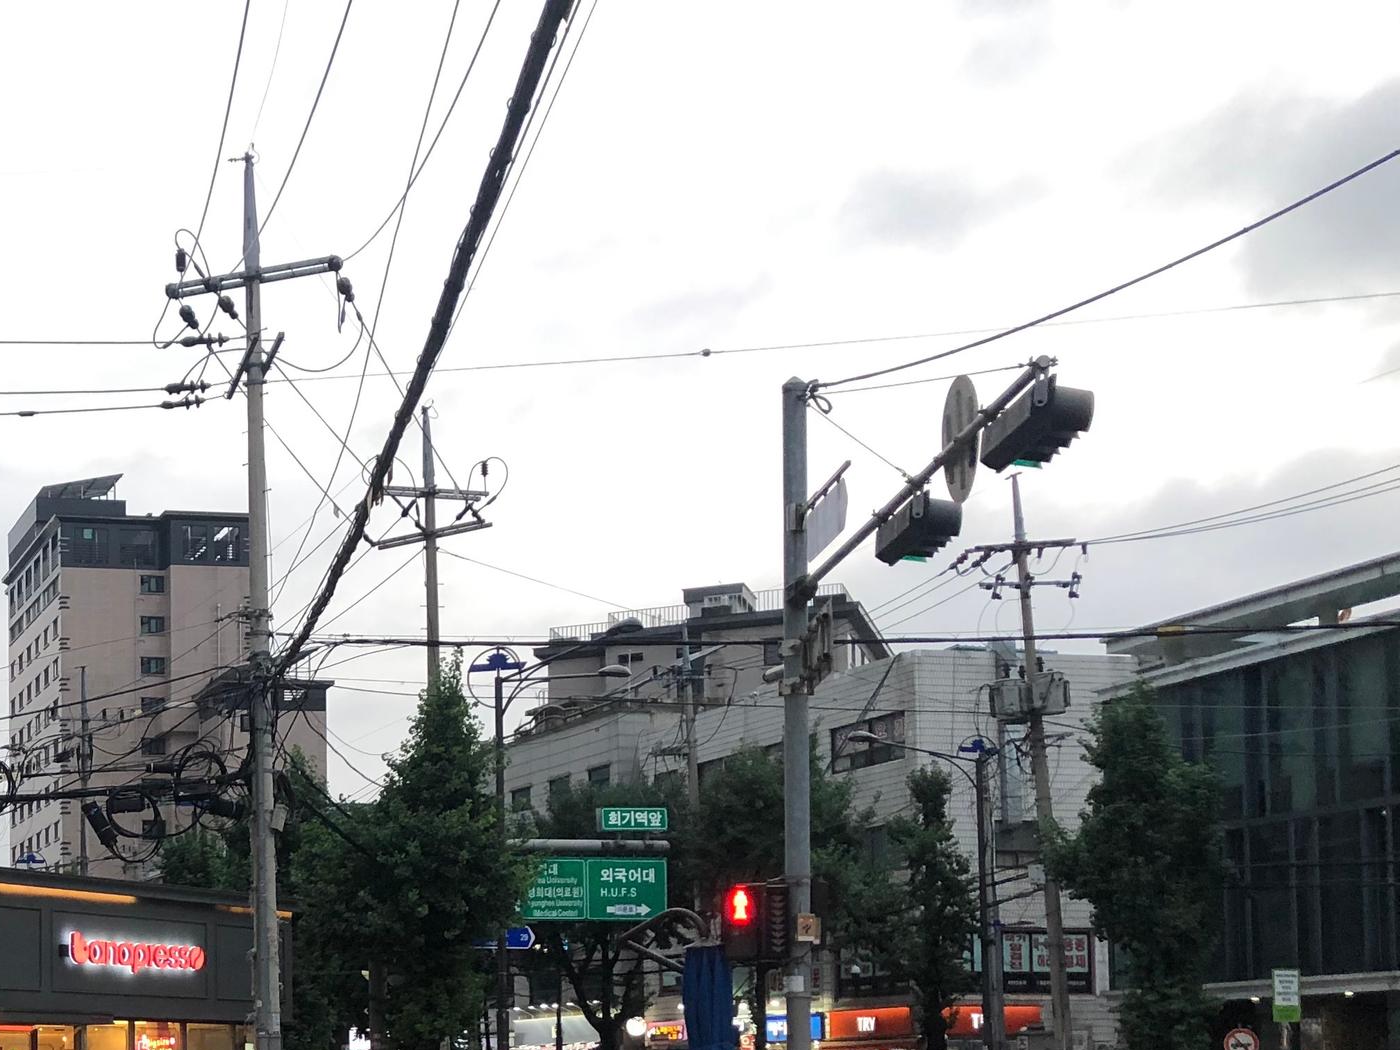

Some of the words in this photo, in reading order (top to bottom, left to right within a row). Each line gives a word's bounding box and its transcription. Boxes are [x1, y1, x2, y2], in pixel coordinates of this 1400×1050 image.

[607, 811, 662, 827] 회기역앞
[600, 867, 656, 884] 외국어대
[600, 888, 637, 898] H.U.F.S
[856, 1016, 876, 1032] TRY
